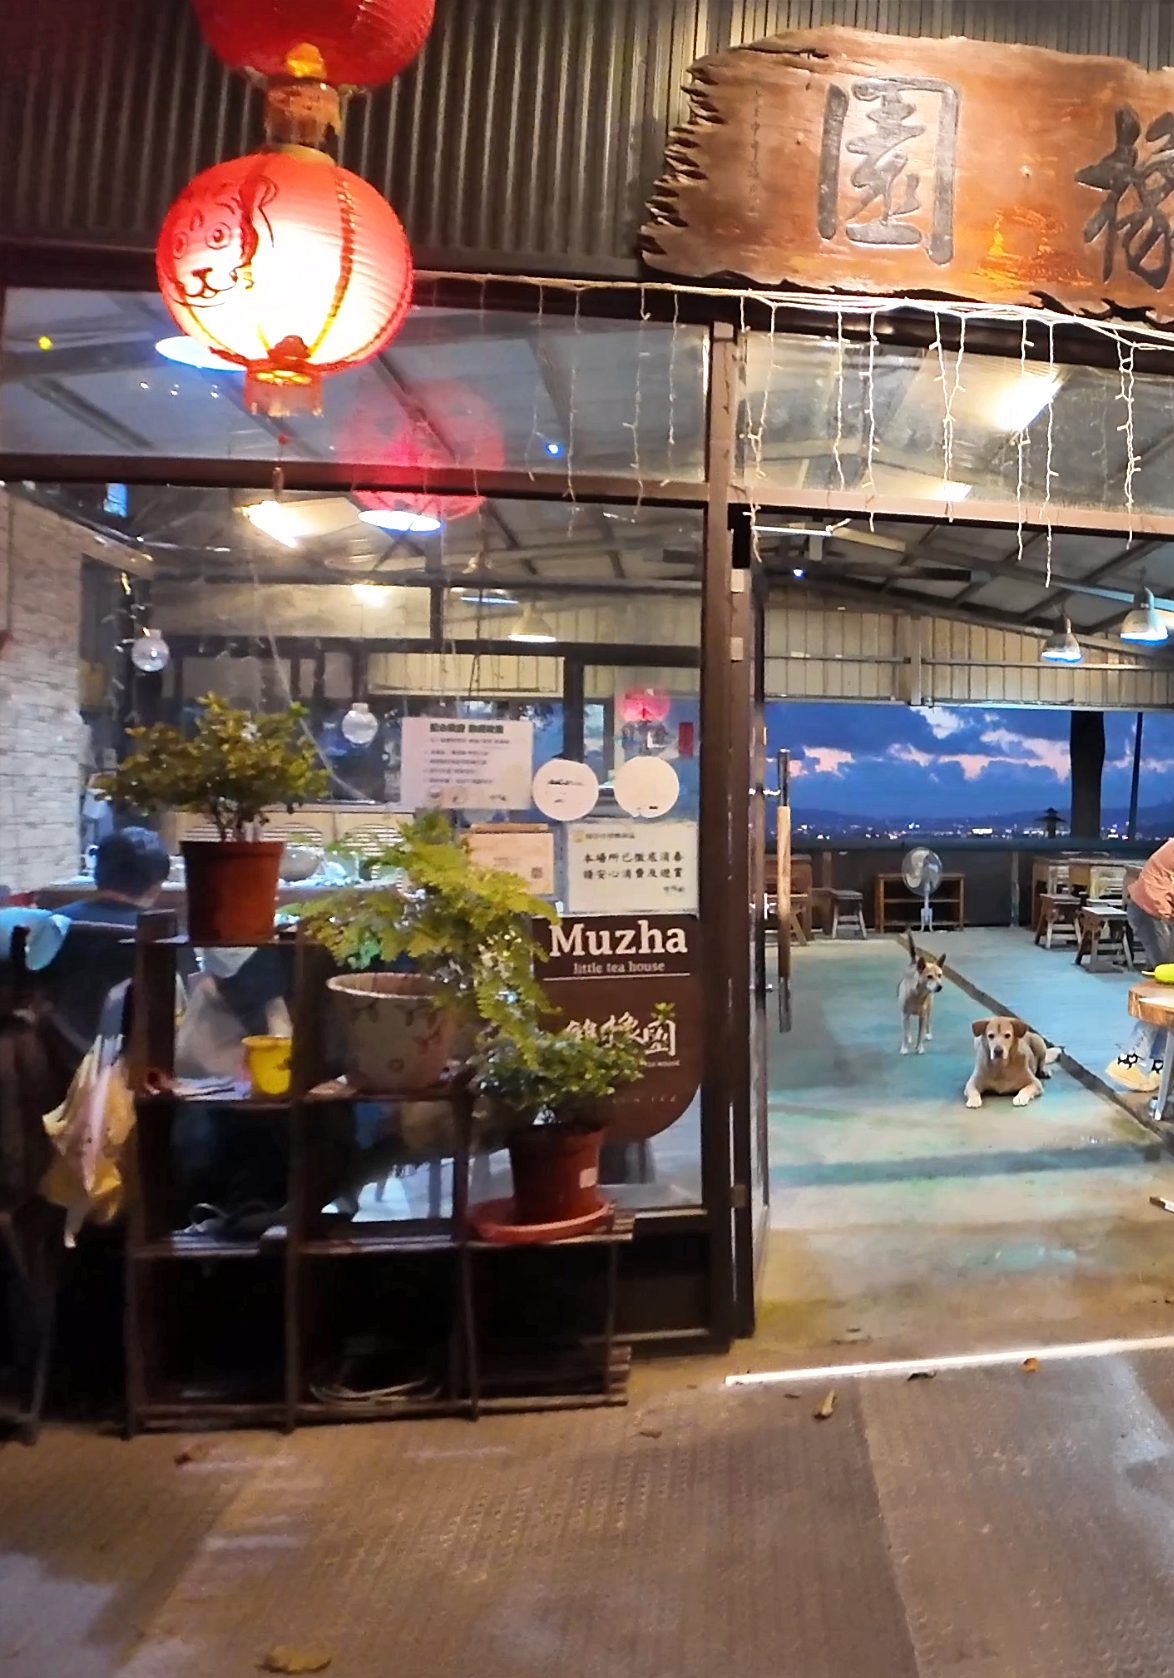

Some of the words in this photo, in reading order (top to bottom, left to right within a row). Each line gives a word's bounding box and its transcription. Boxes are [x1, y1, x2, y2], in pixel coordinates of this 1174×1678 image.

[549, 919, 689, 957] Muzha
[573, 962, 602, 975] little
[606, 962, 625, 973] tea
[628, 960, 665, 973] house
